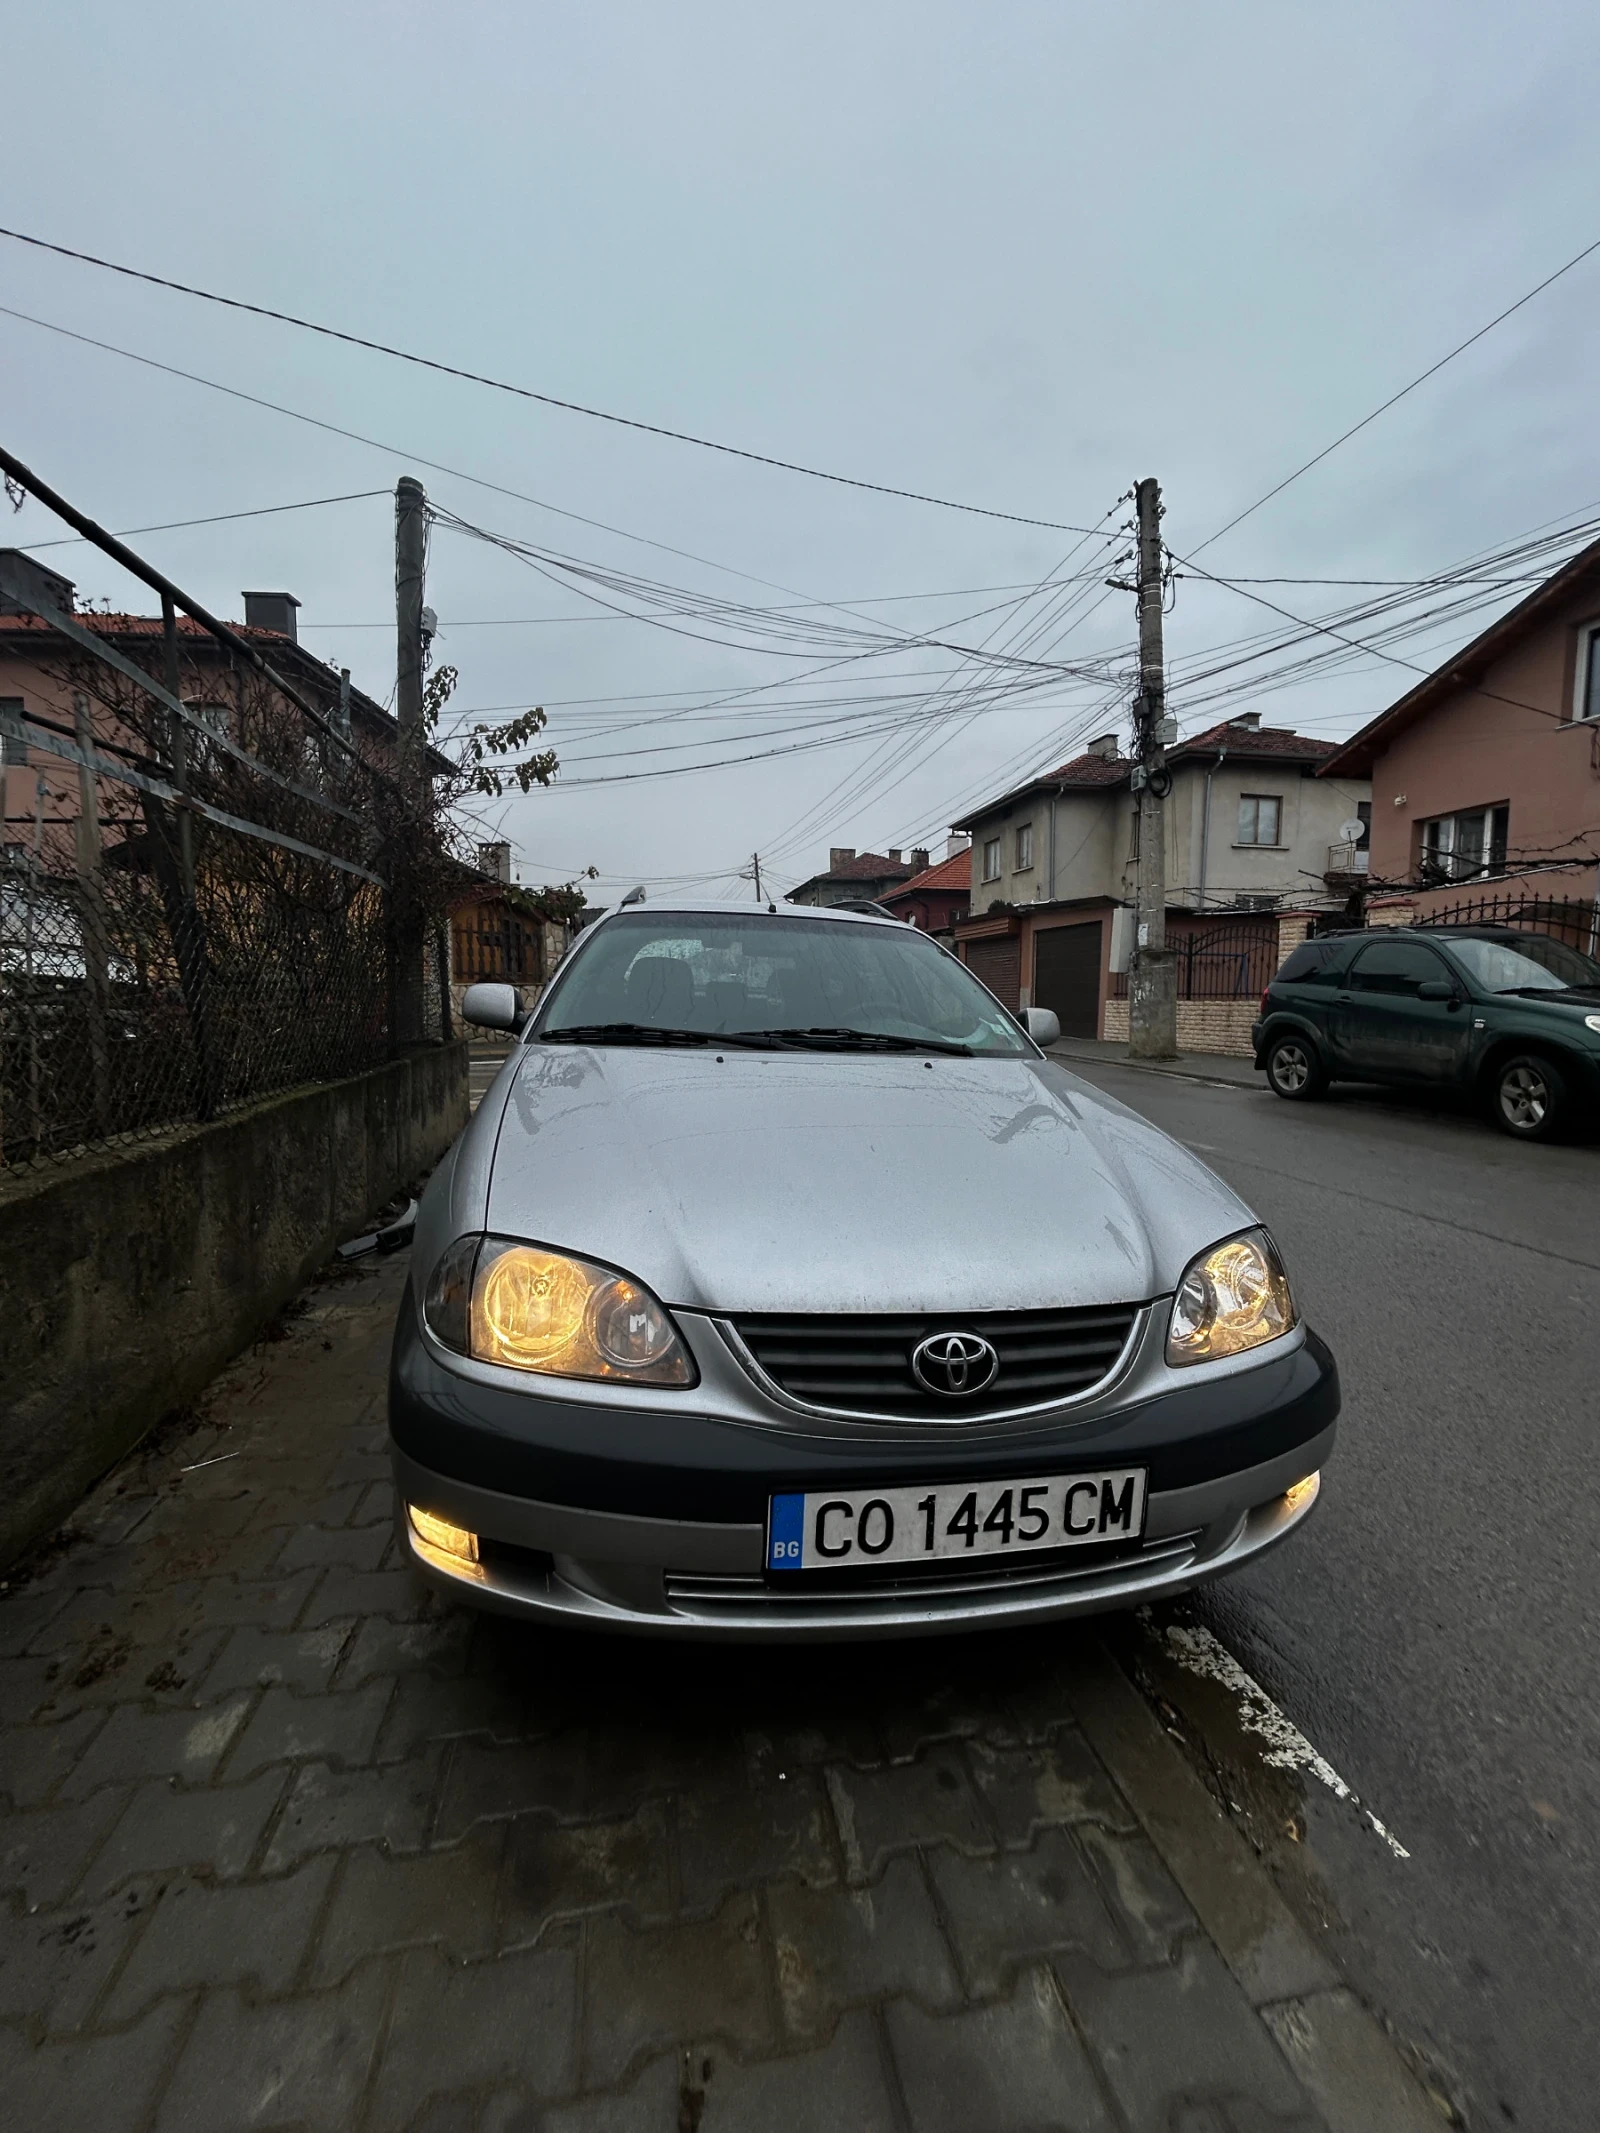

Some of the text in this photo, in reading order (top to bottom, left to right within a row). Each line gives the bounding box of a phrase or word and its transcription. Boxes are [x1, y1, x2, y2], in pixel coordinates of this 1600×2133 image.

[815, 1476, 1135, 1558] CO 1445 CM
[773, 1541, 799, 1559] BG
